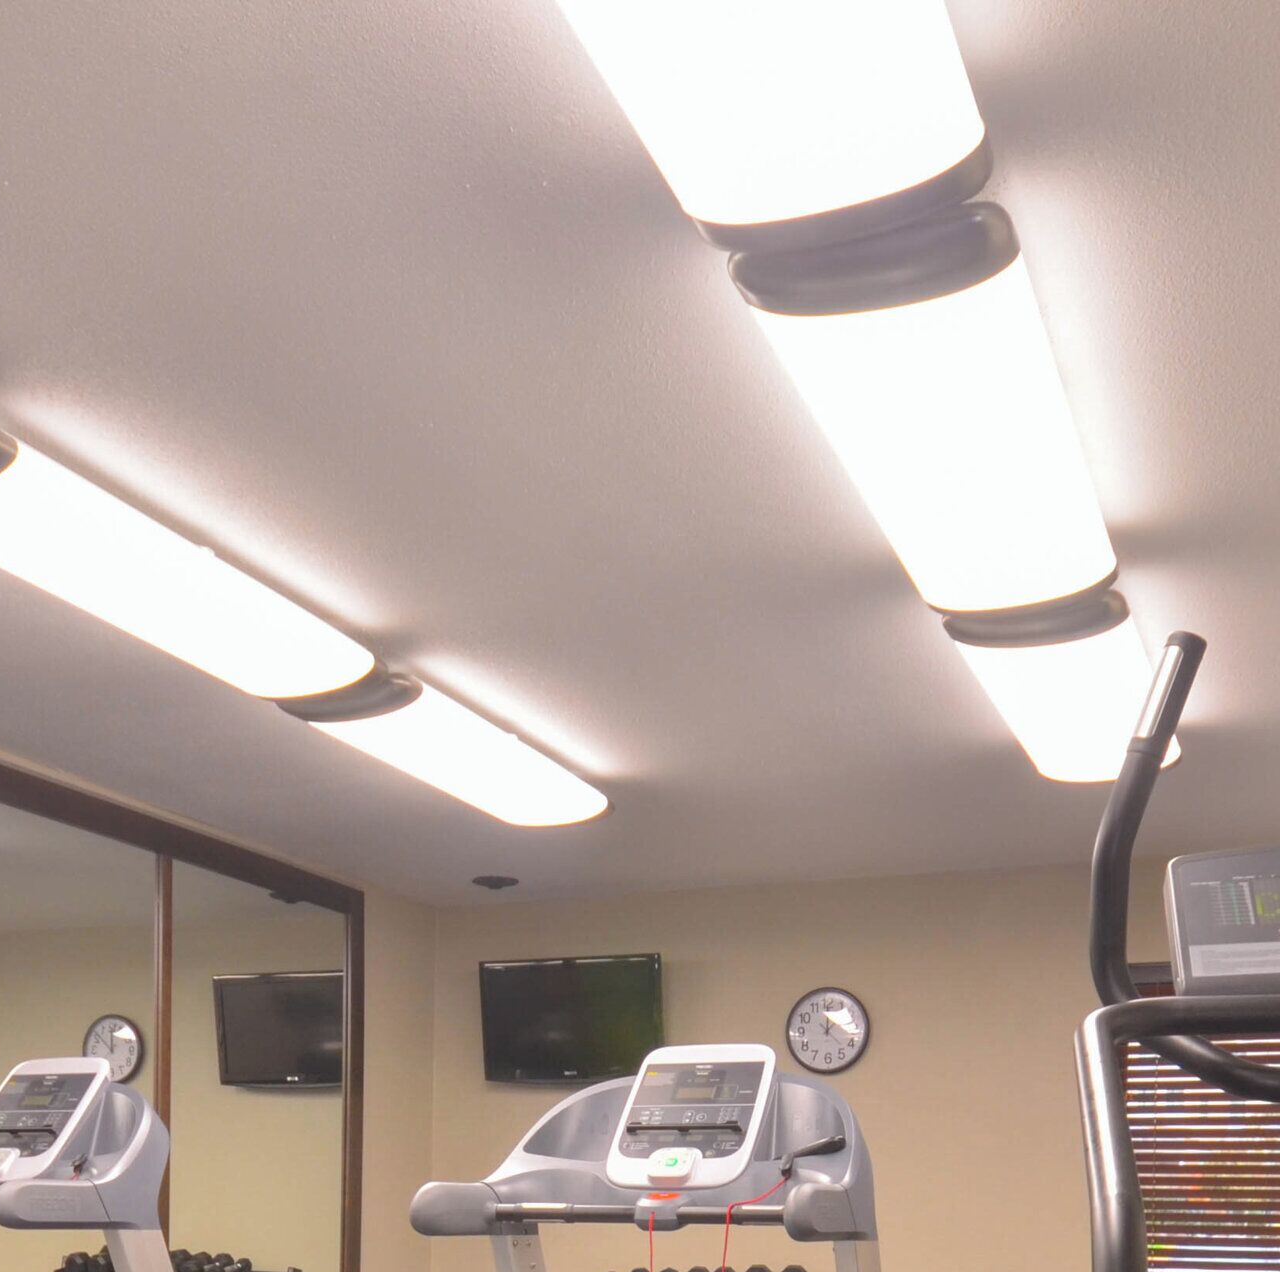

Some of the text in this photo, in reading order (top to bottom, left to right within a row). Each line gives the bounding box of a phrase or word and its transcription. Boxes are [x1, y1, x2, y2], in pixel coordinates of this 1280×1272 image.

[810, 1002, 819, 1013] 11
[799, 1012, 811, 1024] 10
[797, 1026, 805, 1038] 9
[847, 1038, 855, 1049] 4
[811, 1050, 819, 1061] 7
[824, 1052, 833, 1064] 6
[838, 1047, 846, 1060] 5
